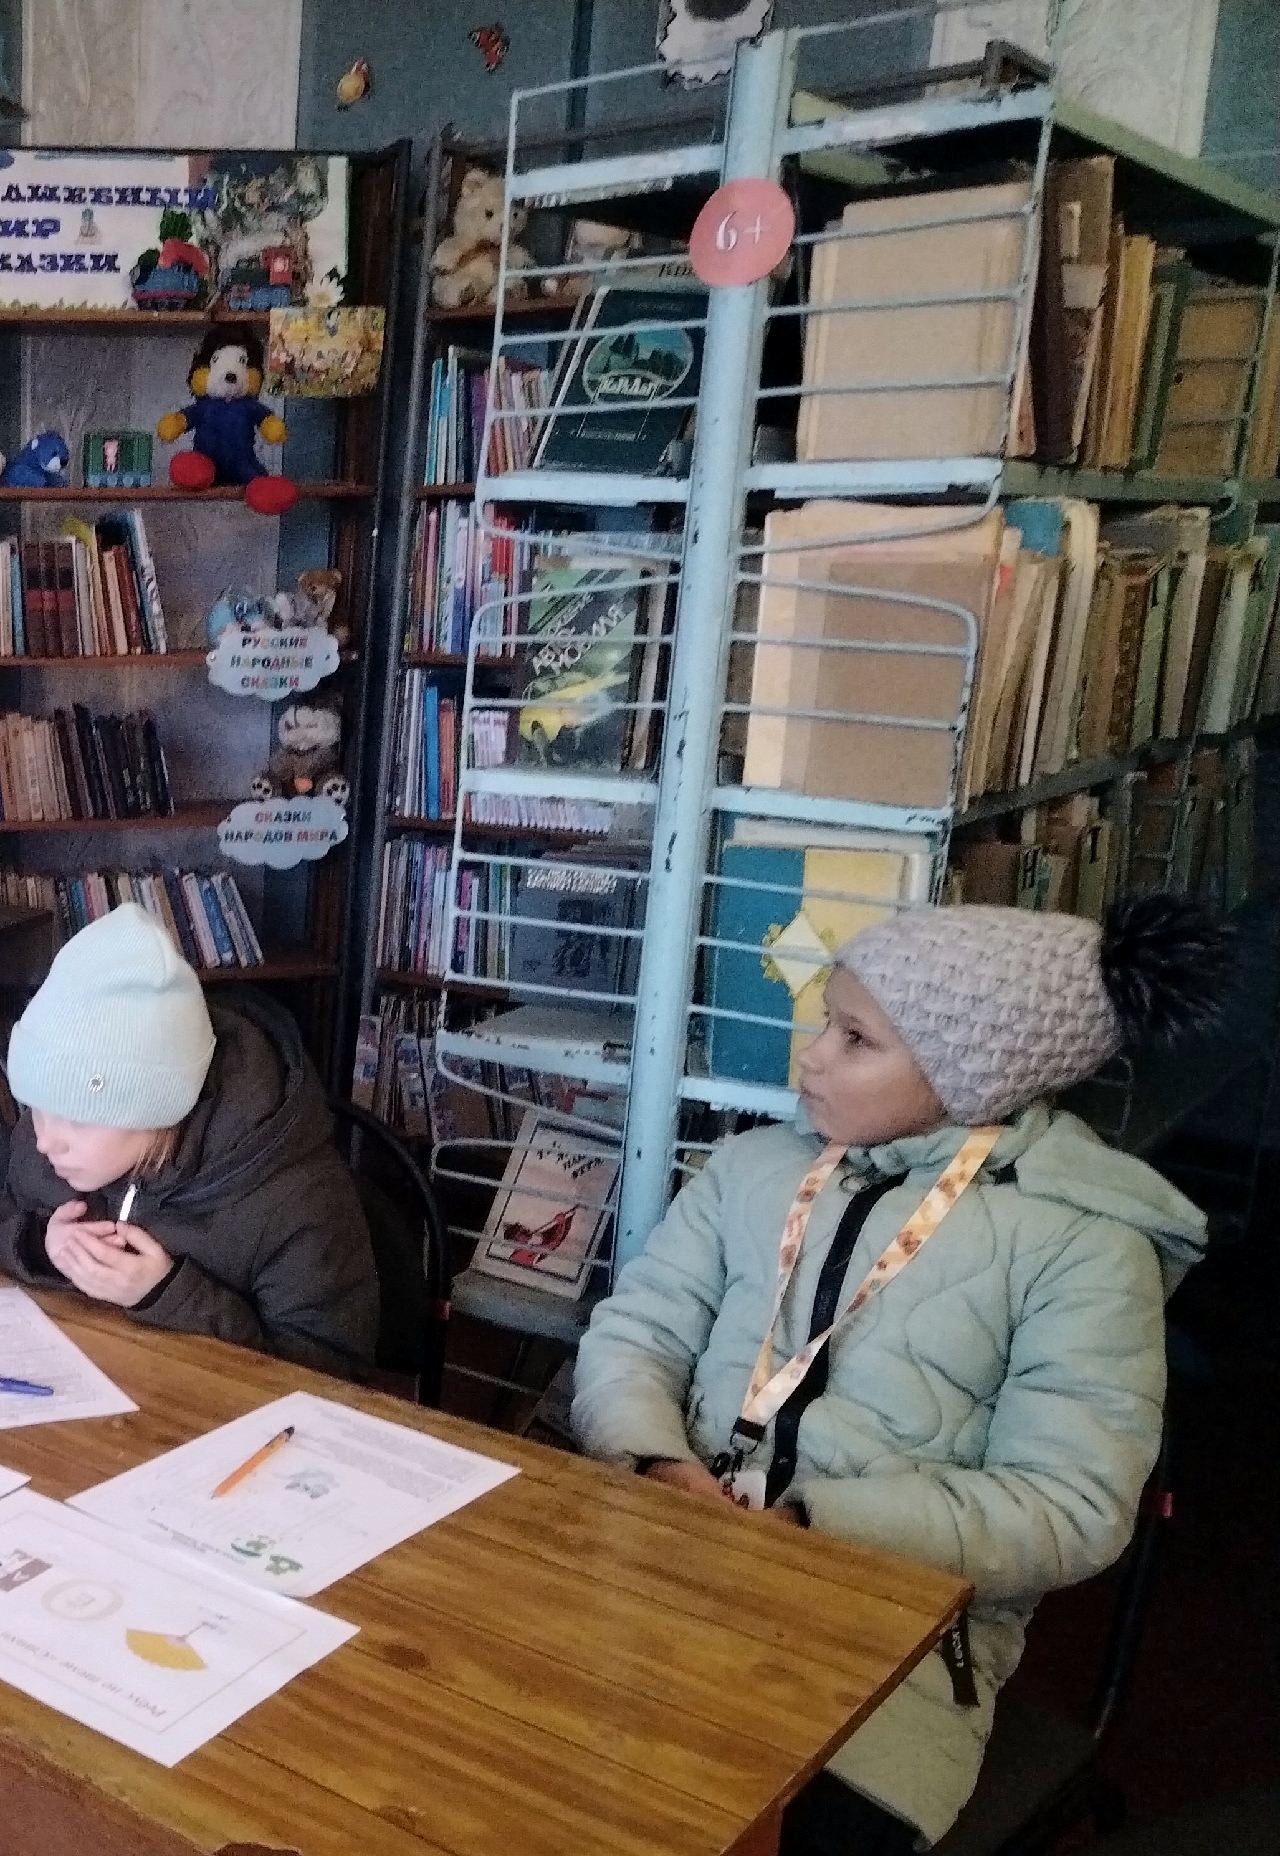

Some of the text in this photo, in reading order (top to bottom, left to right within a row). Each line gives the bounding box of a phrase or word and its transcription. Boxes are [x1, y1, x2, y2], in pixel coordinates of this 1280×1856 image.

[715, 210, 764, 251] 6+
[241, 636, 308, 649] РУССКИЕ
[230, 655, 313, 669] НАРОДНЫЕ
[240, 675, 300, 688] СКАЗКИ
[254, 810, 312, 824] СКАЗКИ
[223, 828, 339, 843] НАРОДОВ МИРА
